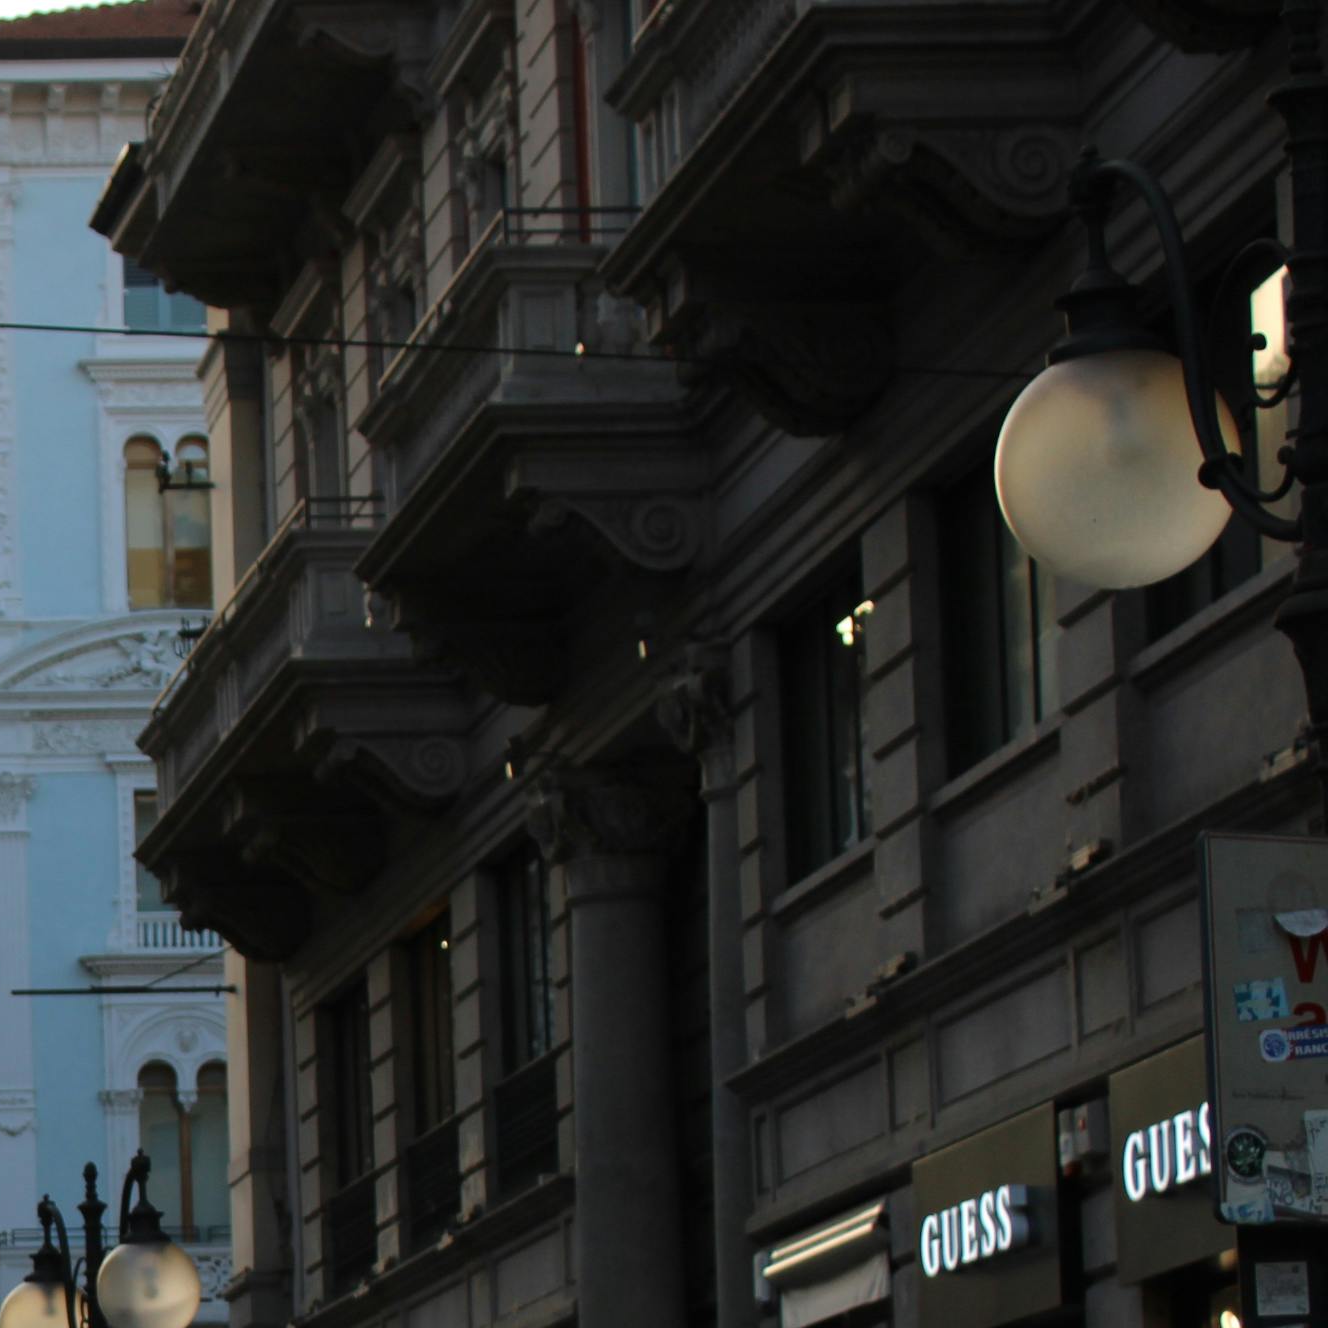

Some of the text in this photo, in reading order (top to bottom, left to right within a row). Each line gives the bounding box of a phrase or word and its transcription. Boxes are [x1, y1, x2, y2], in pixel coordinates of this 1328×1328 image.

[1286, 1043, 1328, 1057] FRANC
[1122, 1101, 1212, 1202] GUES
[920, 1184, 1012, 1278] GUESS
